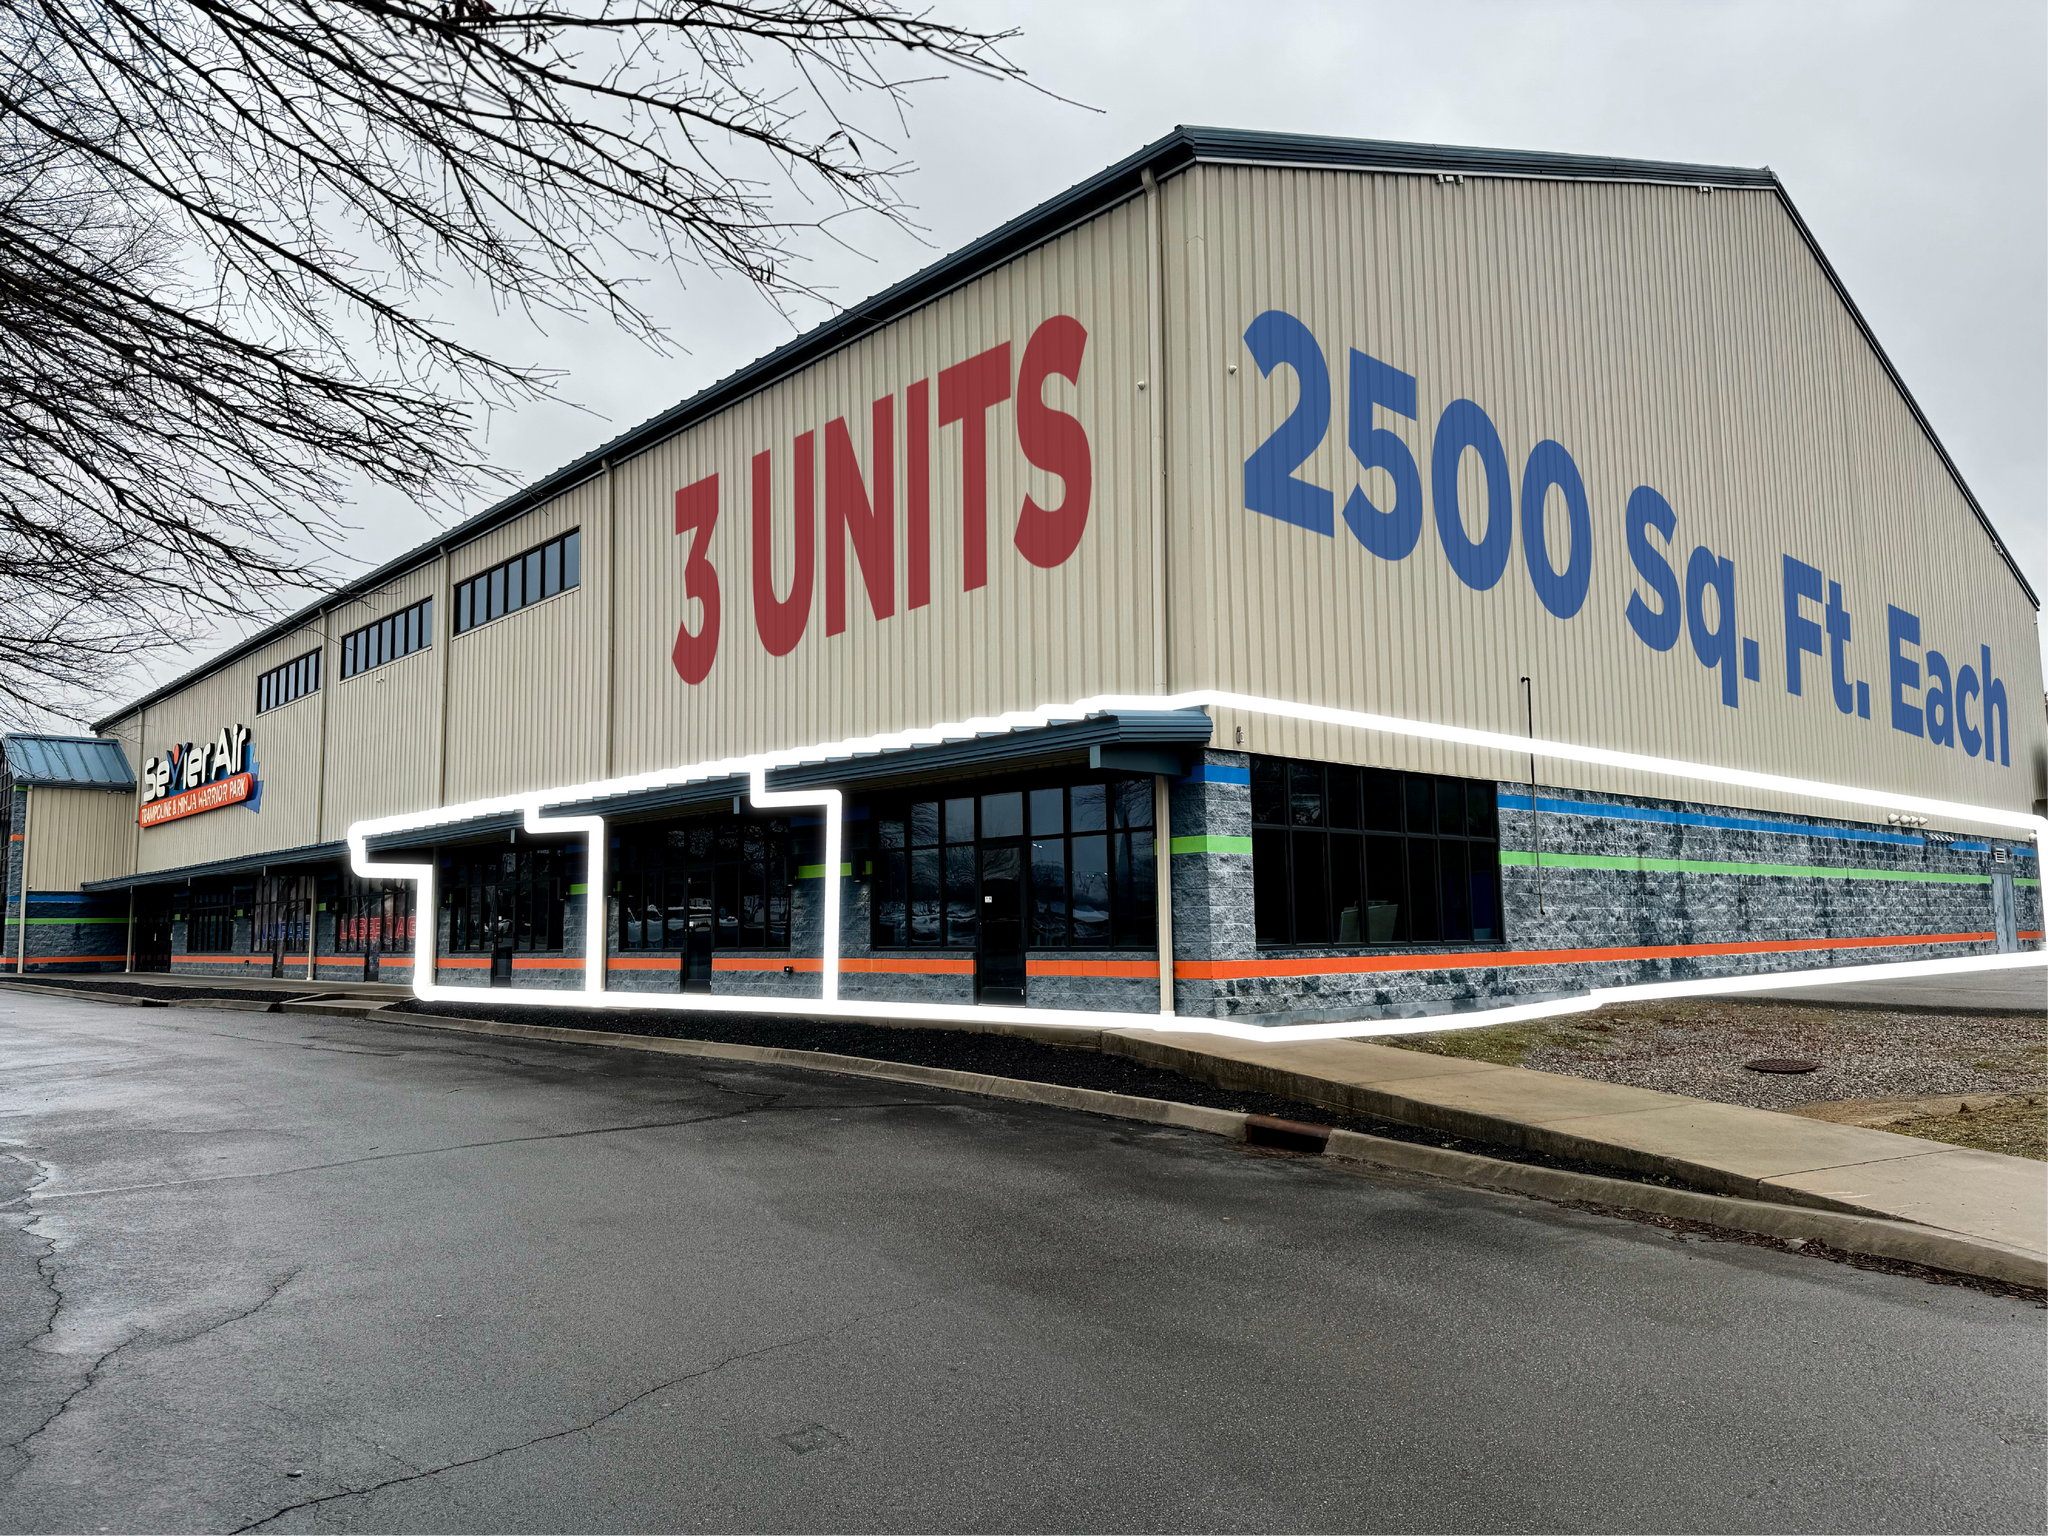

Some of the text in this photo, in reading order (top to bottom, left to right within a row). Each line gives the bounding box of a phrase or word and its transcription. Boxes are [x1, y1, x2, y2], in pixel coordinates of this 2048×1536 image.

[143, 723, 251, 802] Sevier Air
[141, 800, 172, 825] TRAMPOLINE
[177, 793, 197, 816] NINJA
[198, 783, 228, 808] WARRIOR
[229, 777, 246, 799] PARK
